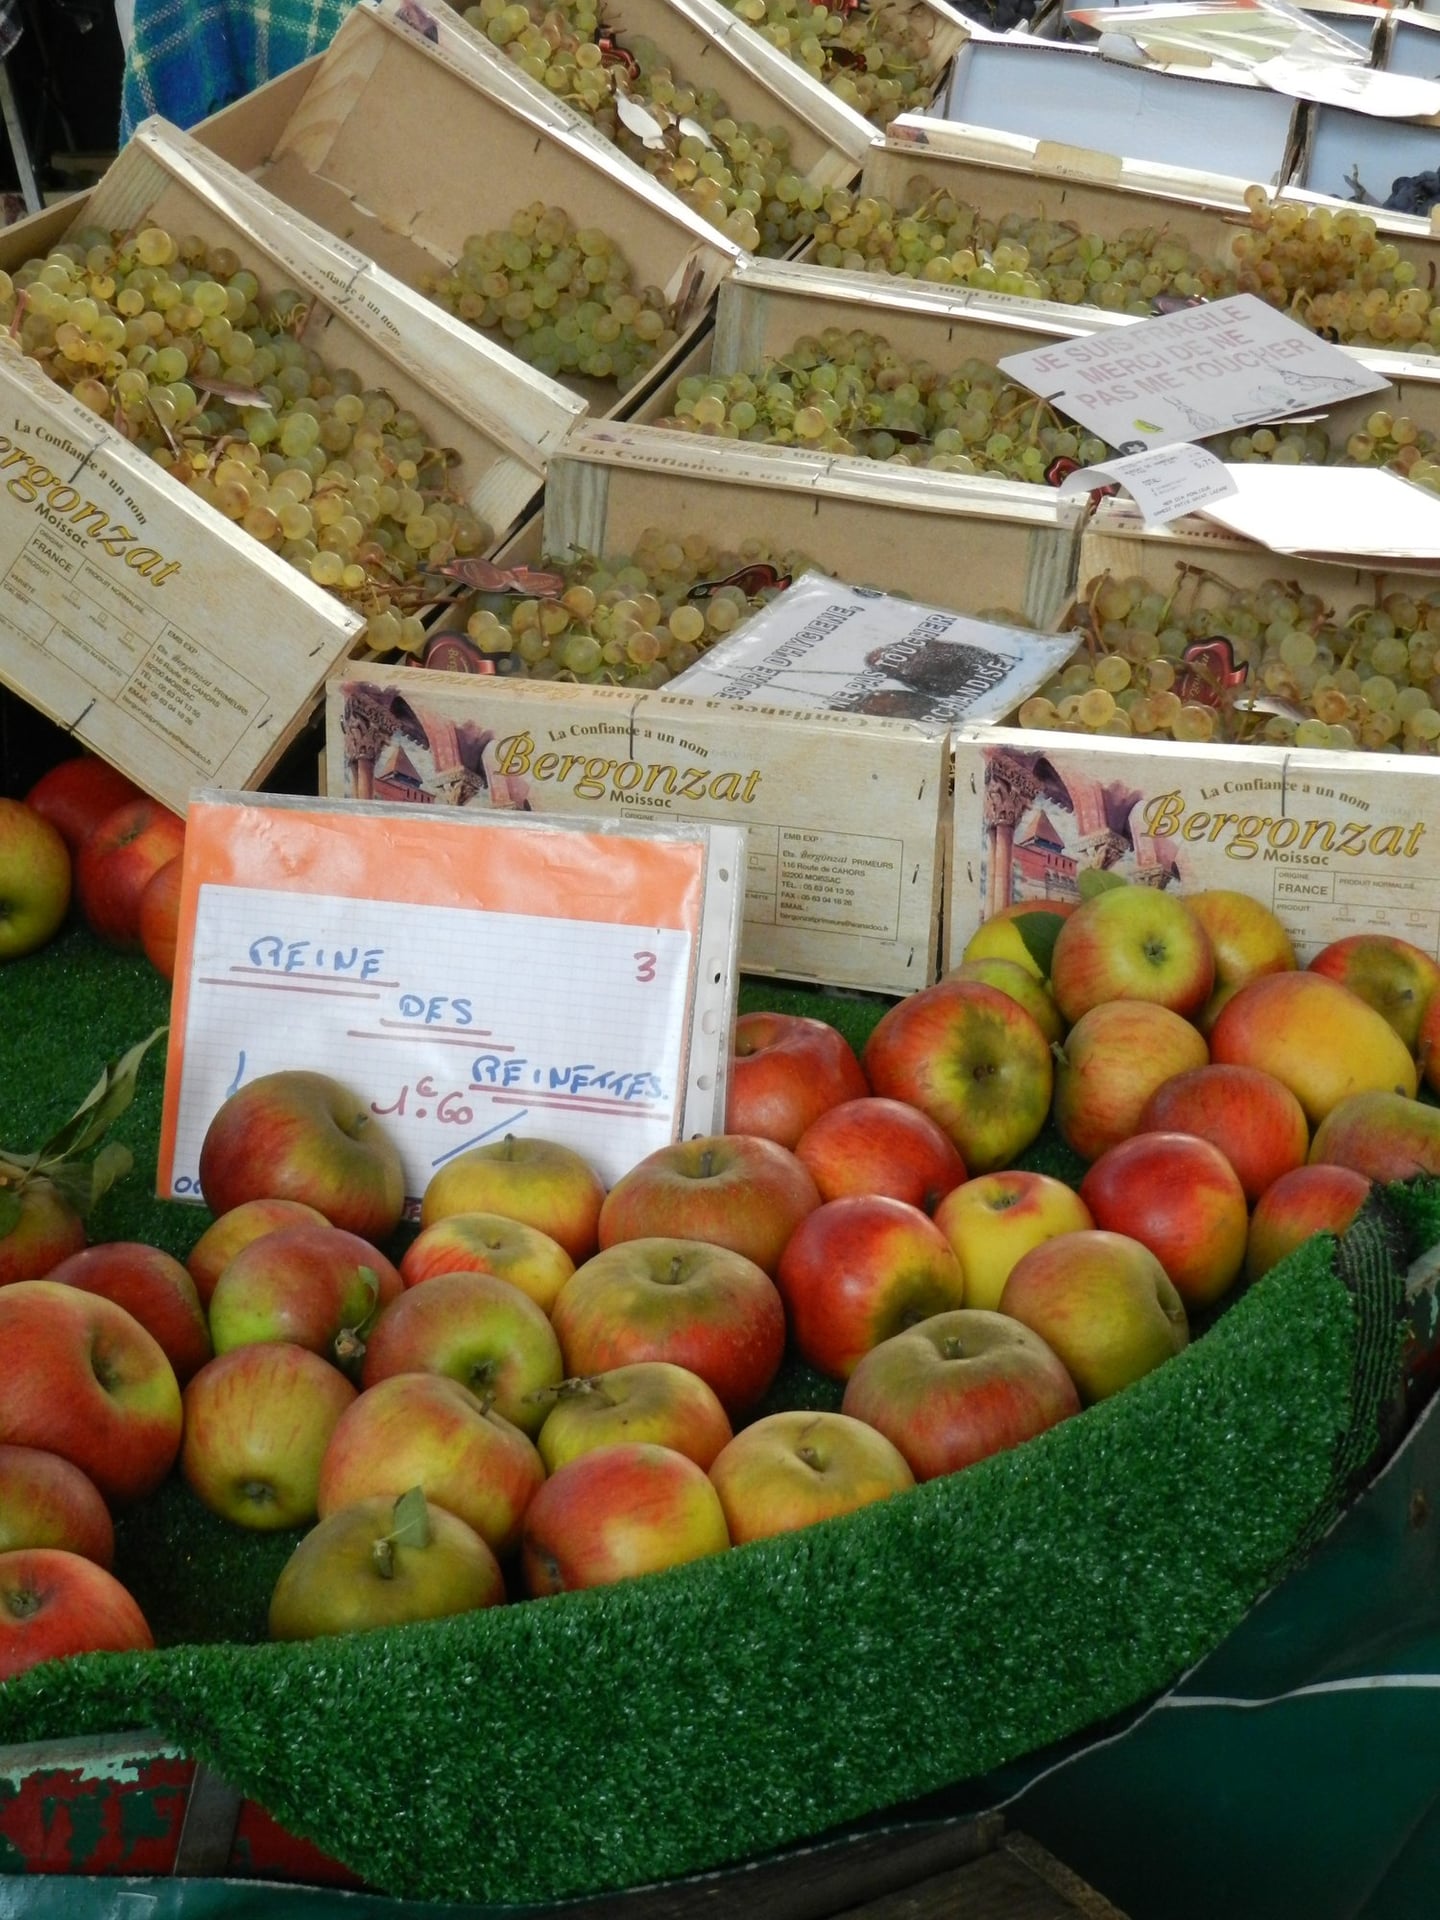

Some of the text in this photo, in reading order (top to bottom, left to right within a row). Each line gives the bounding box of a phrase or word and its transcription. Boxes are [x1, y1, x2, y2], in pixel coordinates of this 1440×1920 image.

[1032, 304, 1251, 375] JE SUIS FRAGILE
[1075, 328, 1255, 385] MERCI DE NE
[1075, 337, 1318, 411] PAS ME TOUCHER
[13, 418, 147, 527] La Confiance a un nom
[34, 502, 90, 551] Moissac
[31, 538, 74, 573] FRANCE
[845, 669, 888, 698] PAS
[873, 613, 959, 669] TOUCHER
[548, 722, 710, 758] La Confiance a un nom
[493, 729, 763, 803] Bergonzat
[609, 789, 673, 808] Moissac
[1199, 787, 1221, 801] La
[1223, 778, 1298, 794] Confiance
[1301, 783, 1311, 792] a
[1315, 785, 1335, 799] un
[1339, 792, 1371, 812] nom
[1140, 789, 1427, 860] Bergonzat
[797, 863, 819, 872] Route
[820, 865, 830, 873] de
[831, 867, 866, 877] CAHORS
[851, 858, 894, 869] PRIMEURS
[1263, 848, 1329, 866] Moissac
[780, 891, 795, 900] FAX
[804, 873, 841, 885] MOISSAC
[1278, 883, 1329, 895] FRANCE
[1339, 878, 1371, 886] PRODUIT
[248, 934, 658, 983] REINE 3
[399, 994, 474, 1027] DES
